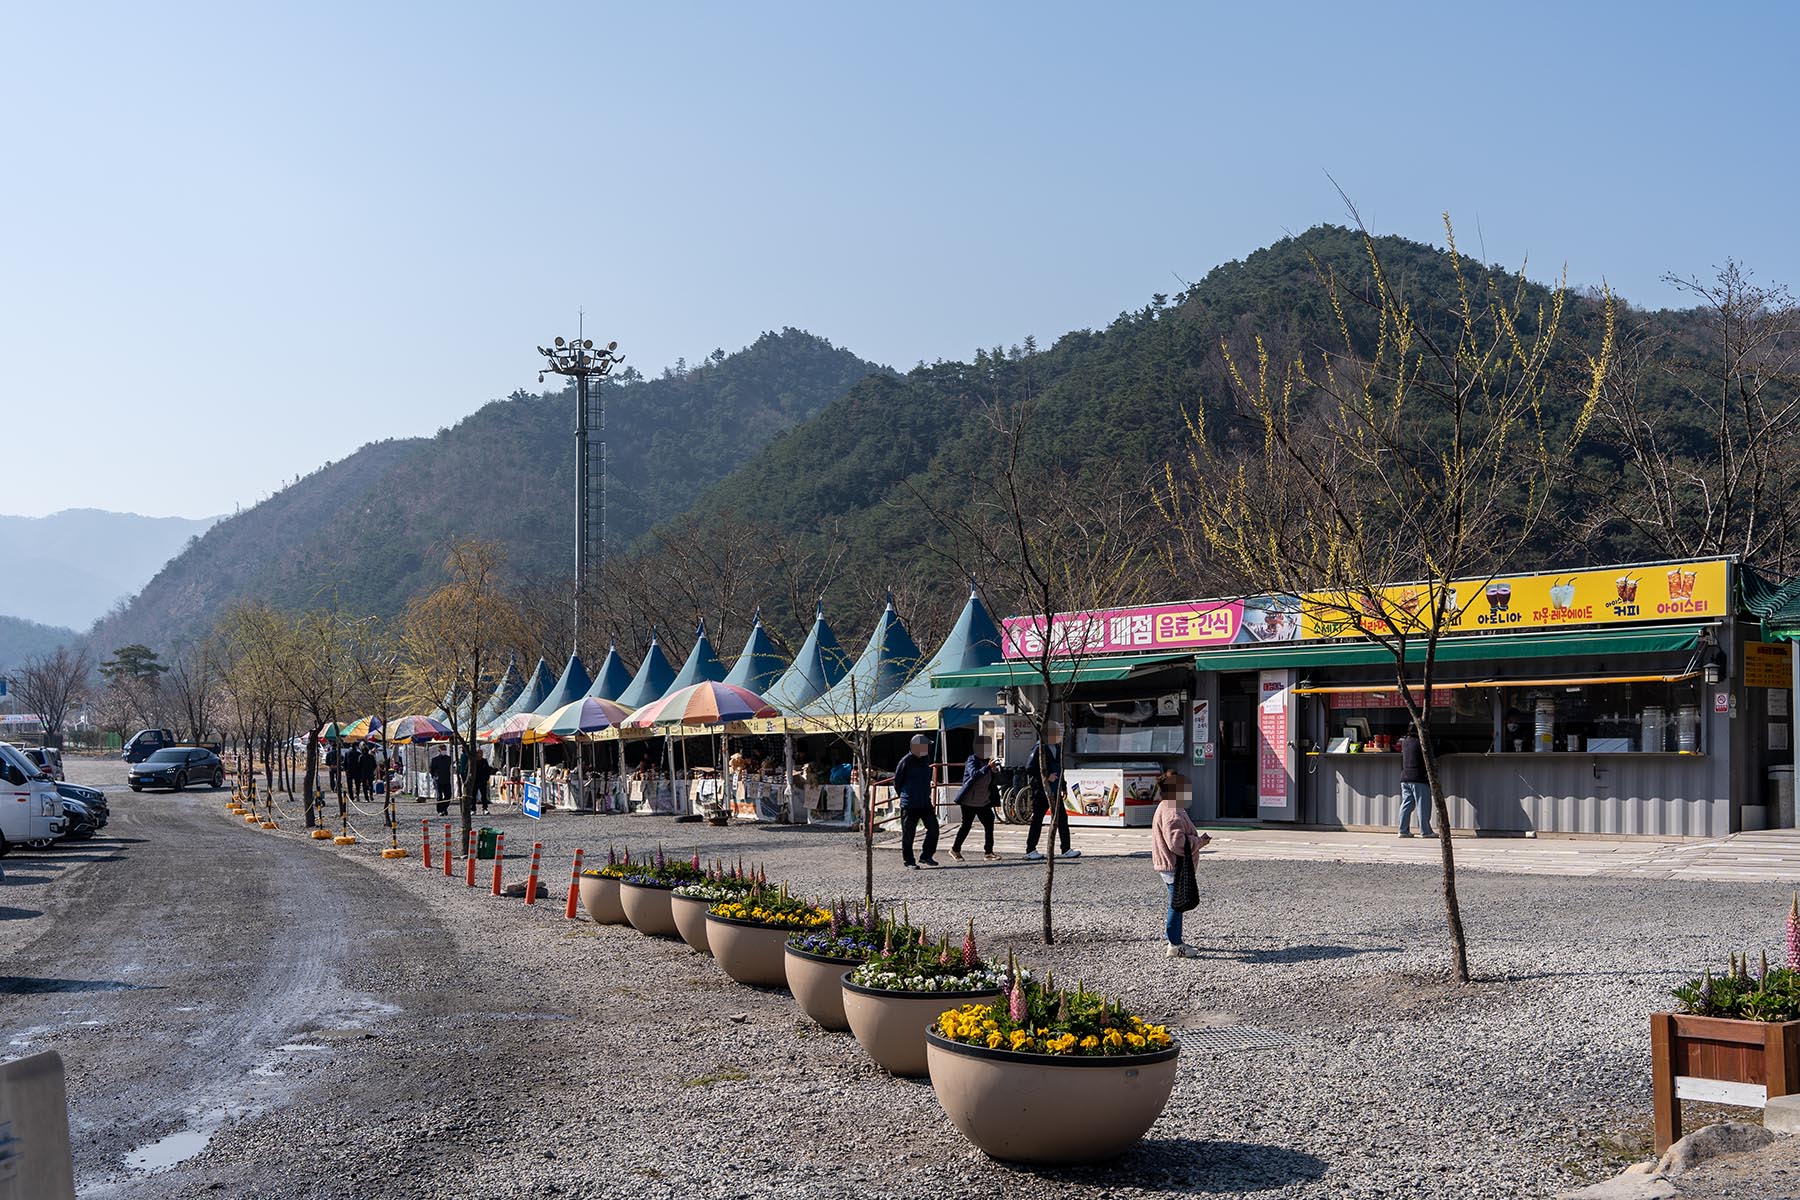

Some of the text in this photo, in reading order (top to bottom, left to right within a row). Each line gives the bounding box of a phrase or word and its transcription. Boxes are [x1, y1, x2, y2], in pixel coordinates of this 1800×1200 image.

[1613, 605, 1640, 616] 커피
[1656, 600, 1708, 614] 아이스티
[1478, 610, 1522, 624] 아로니아
[1533, 605, 1593, 624] 자몽·레몬에이드
[1110, 614, 1153, 646] 매점
[1159, 612, 1228, 638] 음료·간식
